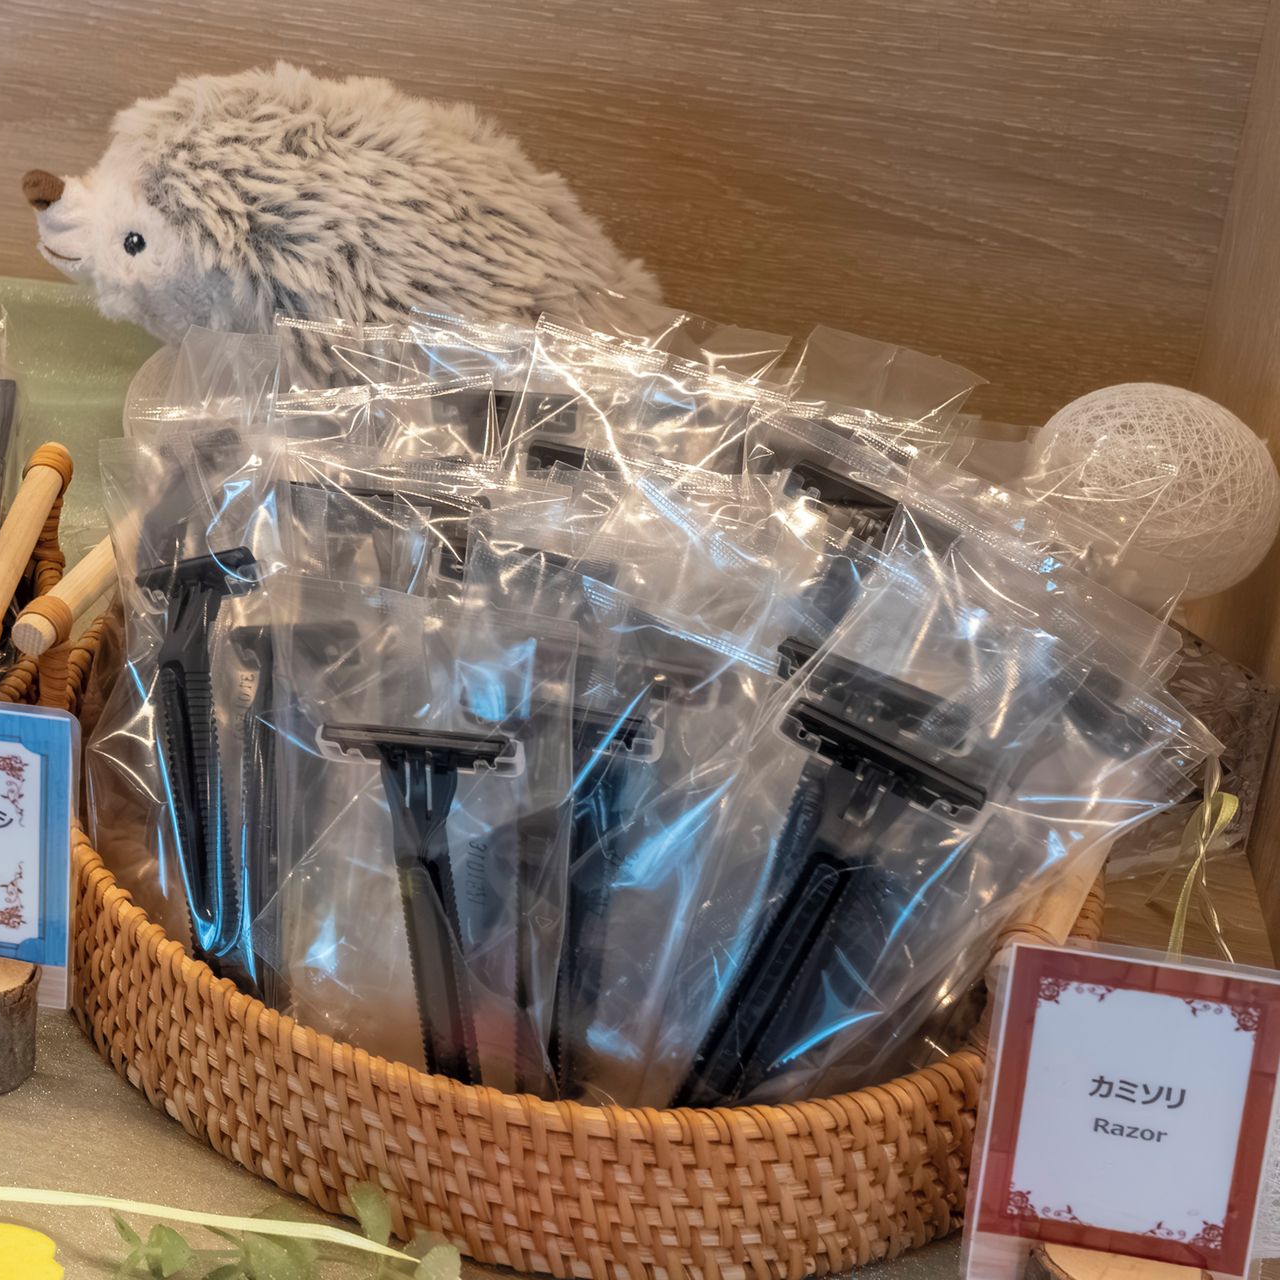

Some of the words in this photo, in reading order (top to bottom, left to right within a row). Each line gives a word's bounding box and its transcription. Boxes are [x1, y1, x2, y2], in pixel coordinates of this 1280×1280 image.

[1088, 1074, 1187, 1109] カミソリ
[1093, 1117, 1168, 1143] Razor
